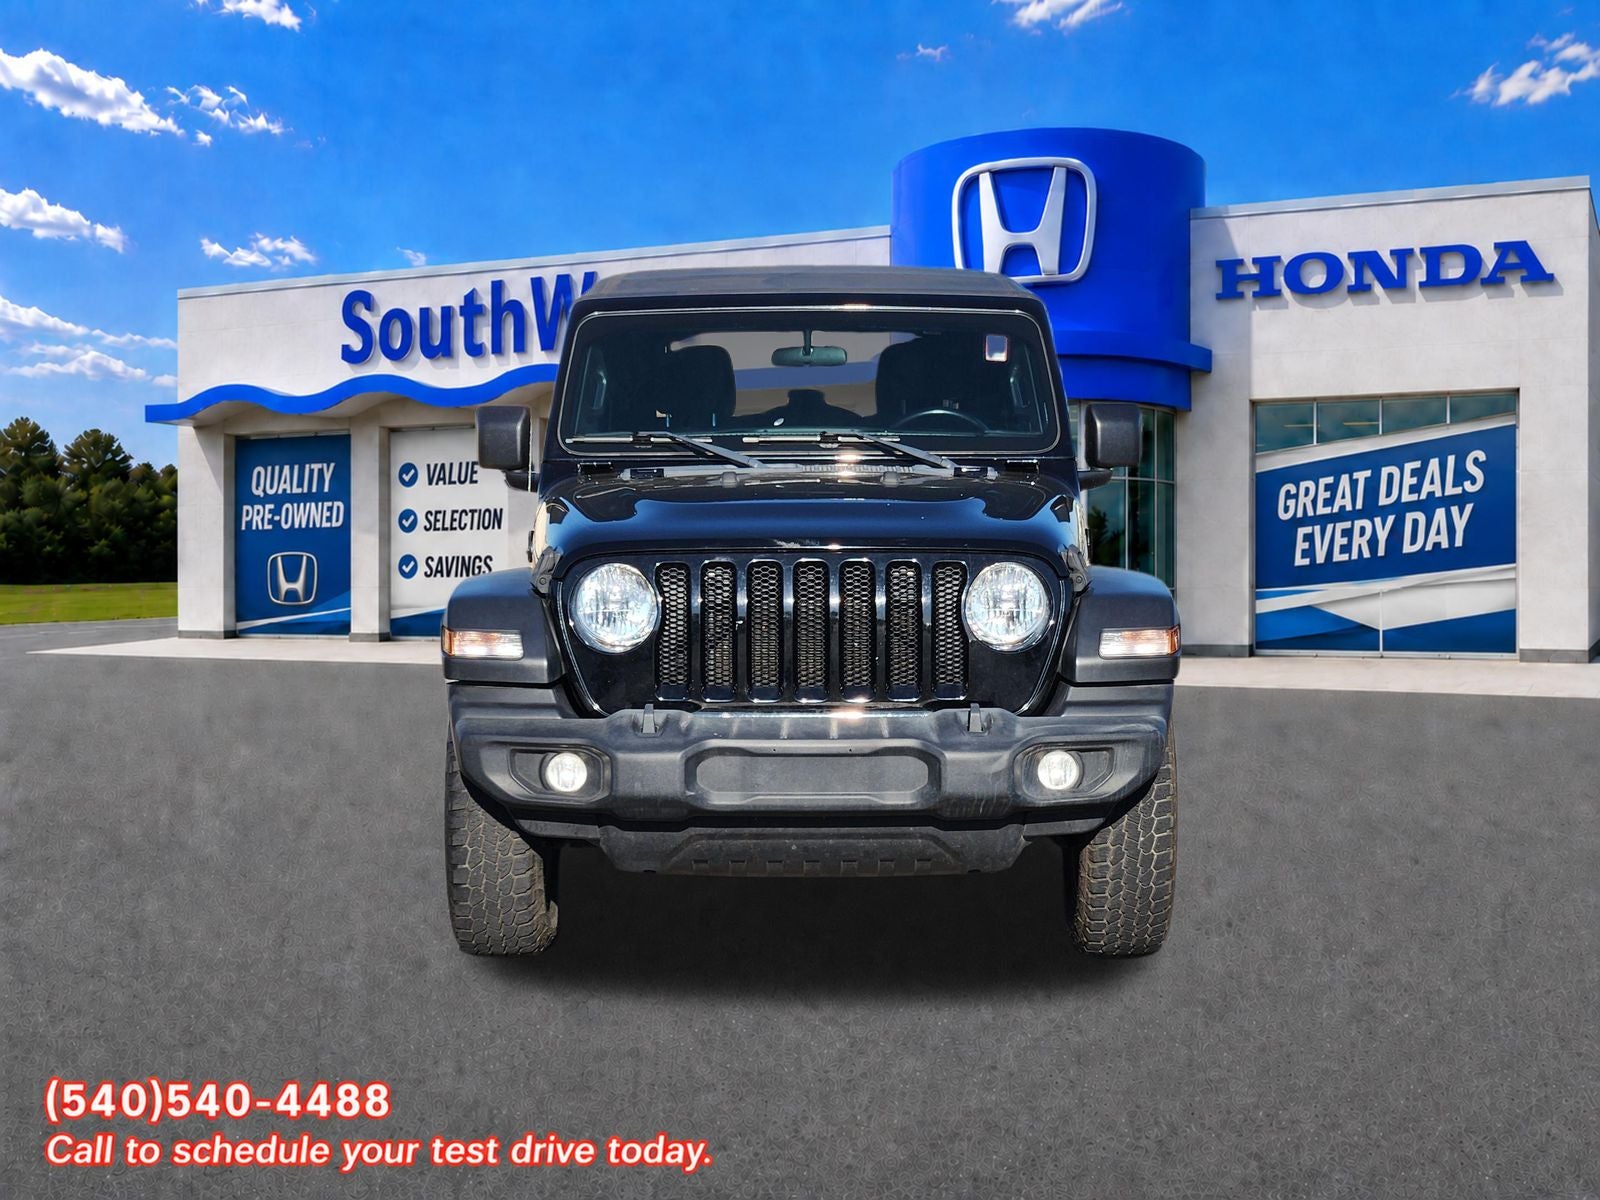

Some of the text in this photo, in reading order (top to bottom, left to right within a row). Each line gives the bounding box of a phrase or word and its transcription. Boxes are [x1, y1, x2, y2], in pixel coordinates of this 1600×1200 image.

[1216, 240, 1554, 300] HONDA
[251, 462, 336, 496] QUALITY
[426, 461, 479, 486] VALUE
[1278, 450, 1487, 521] GREAT DEALS
[241, 501, 344, 531] PRE-OWNED
[423, 508, 503, 532] SELECTION
[1294, 503, 1474, 567] EVERY DAY
[423, 555, 494, 578] SAVINGS
